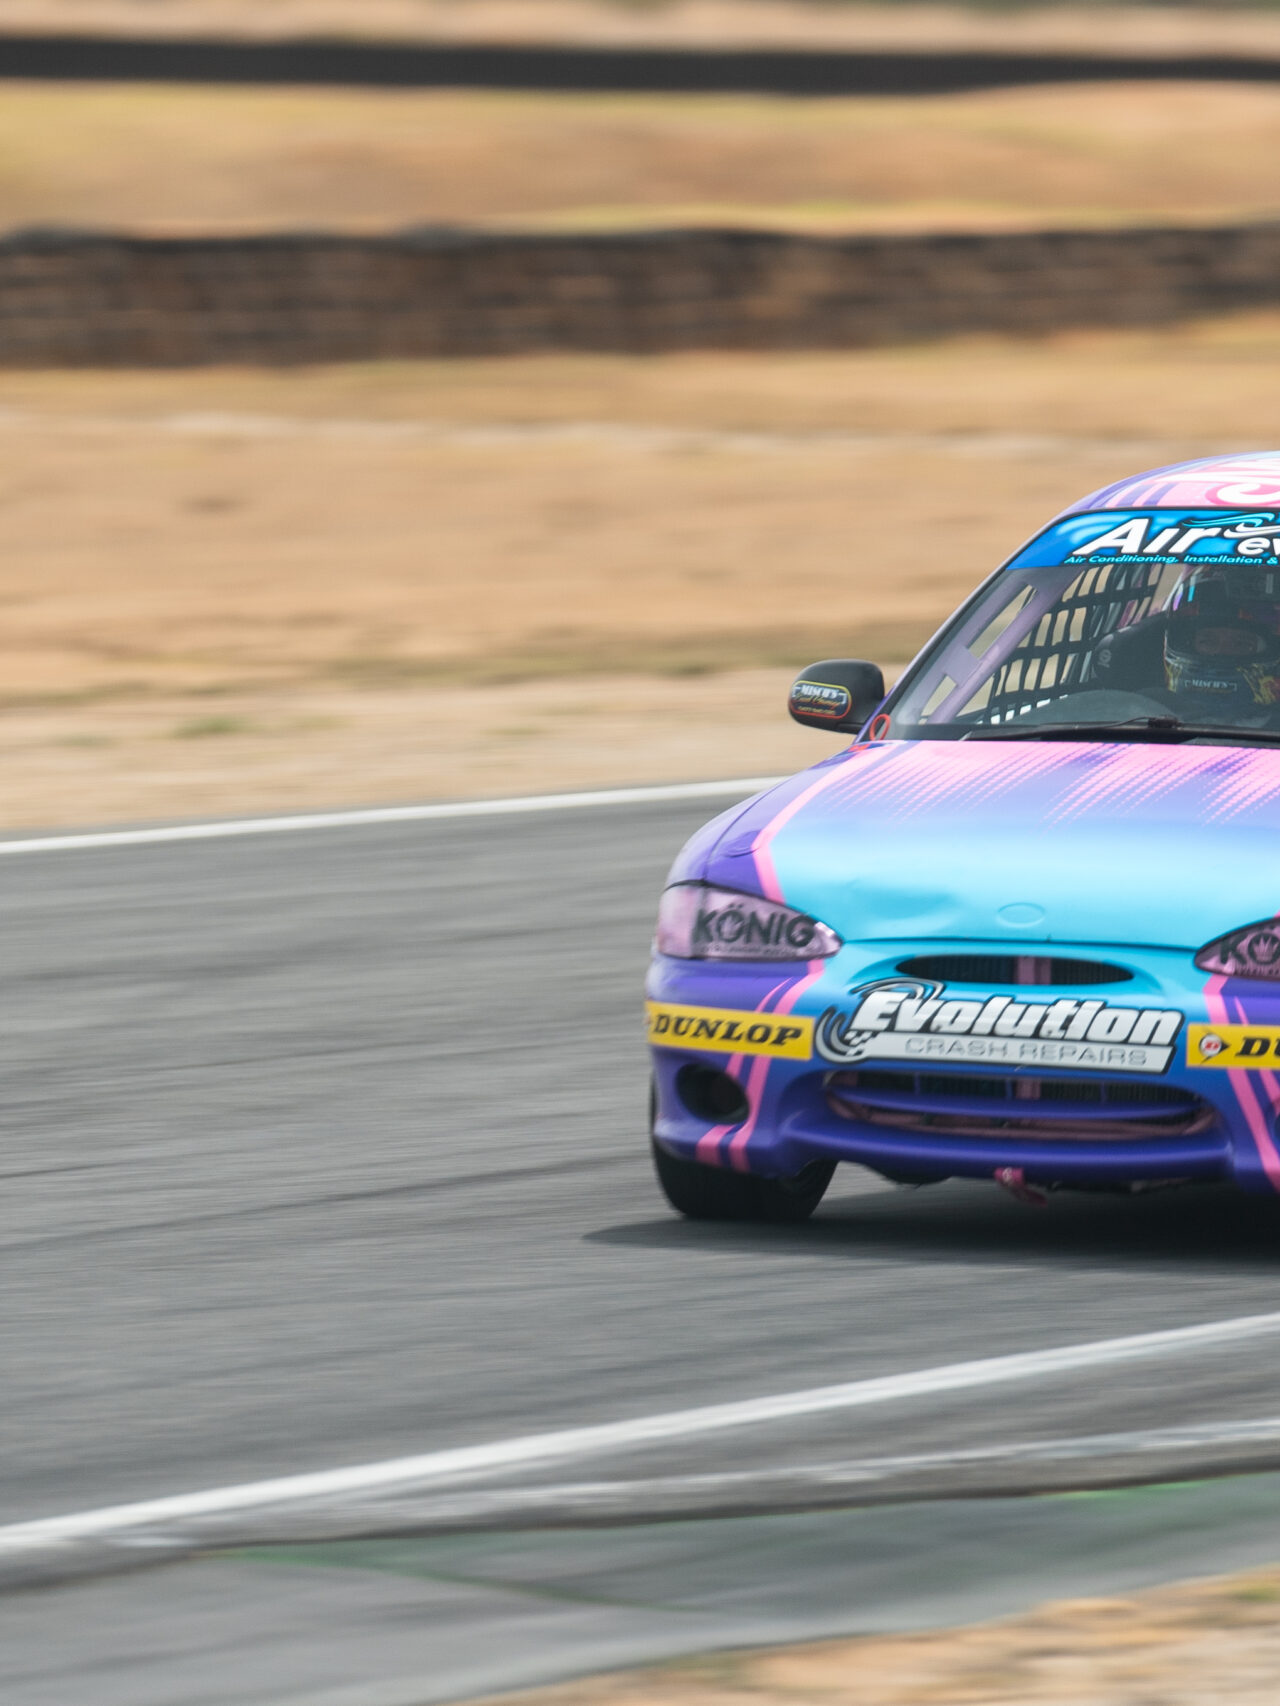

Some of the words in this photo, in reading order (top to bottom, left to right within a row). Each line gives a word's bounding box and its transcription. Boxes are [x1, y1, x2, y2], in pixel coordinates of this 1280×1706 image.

[1072, 517, 1227, 555] Air
[1064, 555, 1084, 565] Air
[1089, 554, 1179, 565] Conditioning,
[1184, 555, 1263, 565] Installation
[1267, 556, 1278, 565] &
[653, 1003, 804, 1046] DUNLOP
[904, 1036, 1009, 1058] CRASH
[1018, 1041, 1148, 1067] REPAIRS
